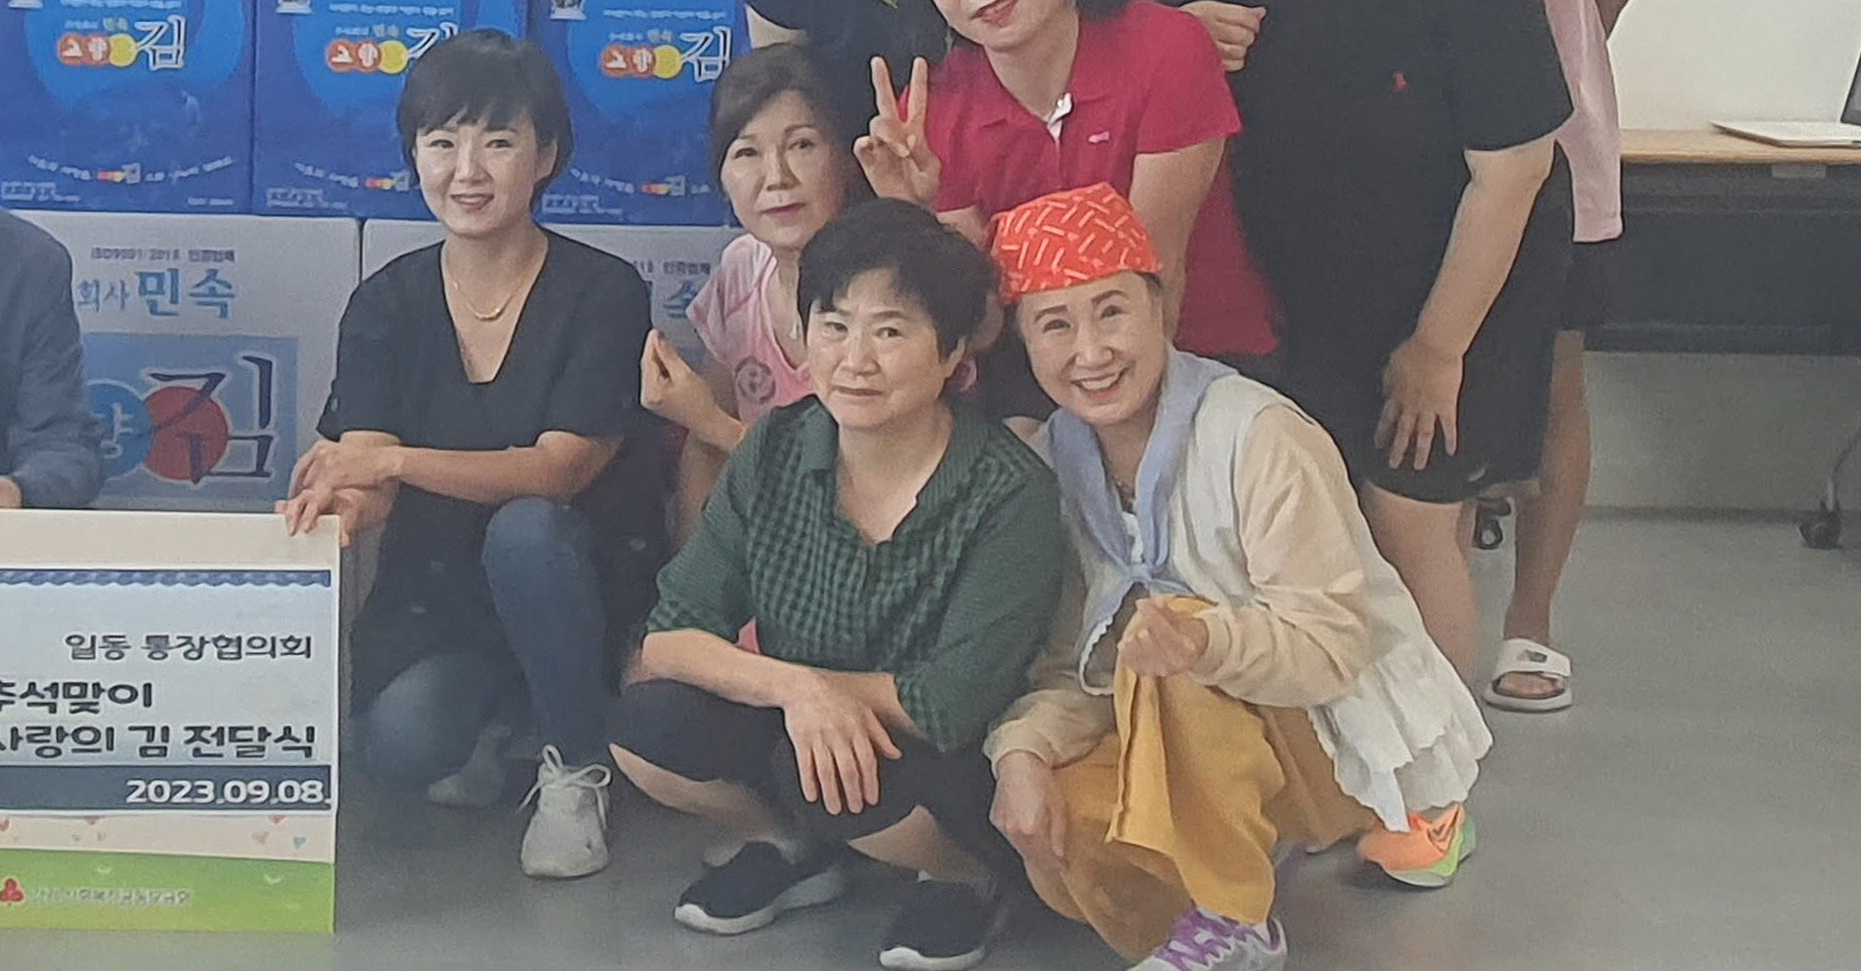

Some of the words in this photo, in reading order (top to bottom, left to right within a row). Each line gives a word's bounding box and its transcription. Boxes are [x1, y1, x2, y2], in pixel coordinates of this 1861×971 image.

[135, 267, 236, 319] 민속
[148, 354, 275, 486] 김
[65, 634, 131, 661] 일동
[141, 634, 313, 661] 통장협의회
[128, 725, 171, 759] 김
[184, 725, 317, 759] 전달식
[125, 779, 333, 806] 2023.09.08.
